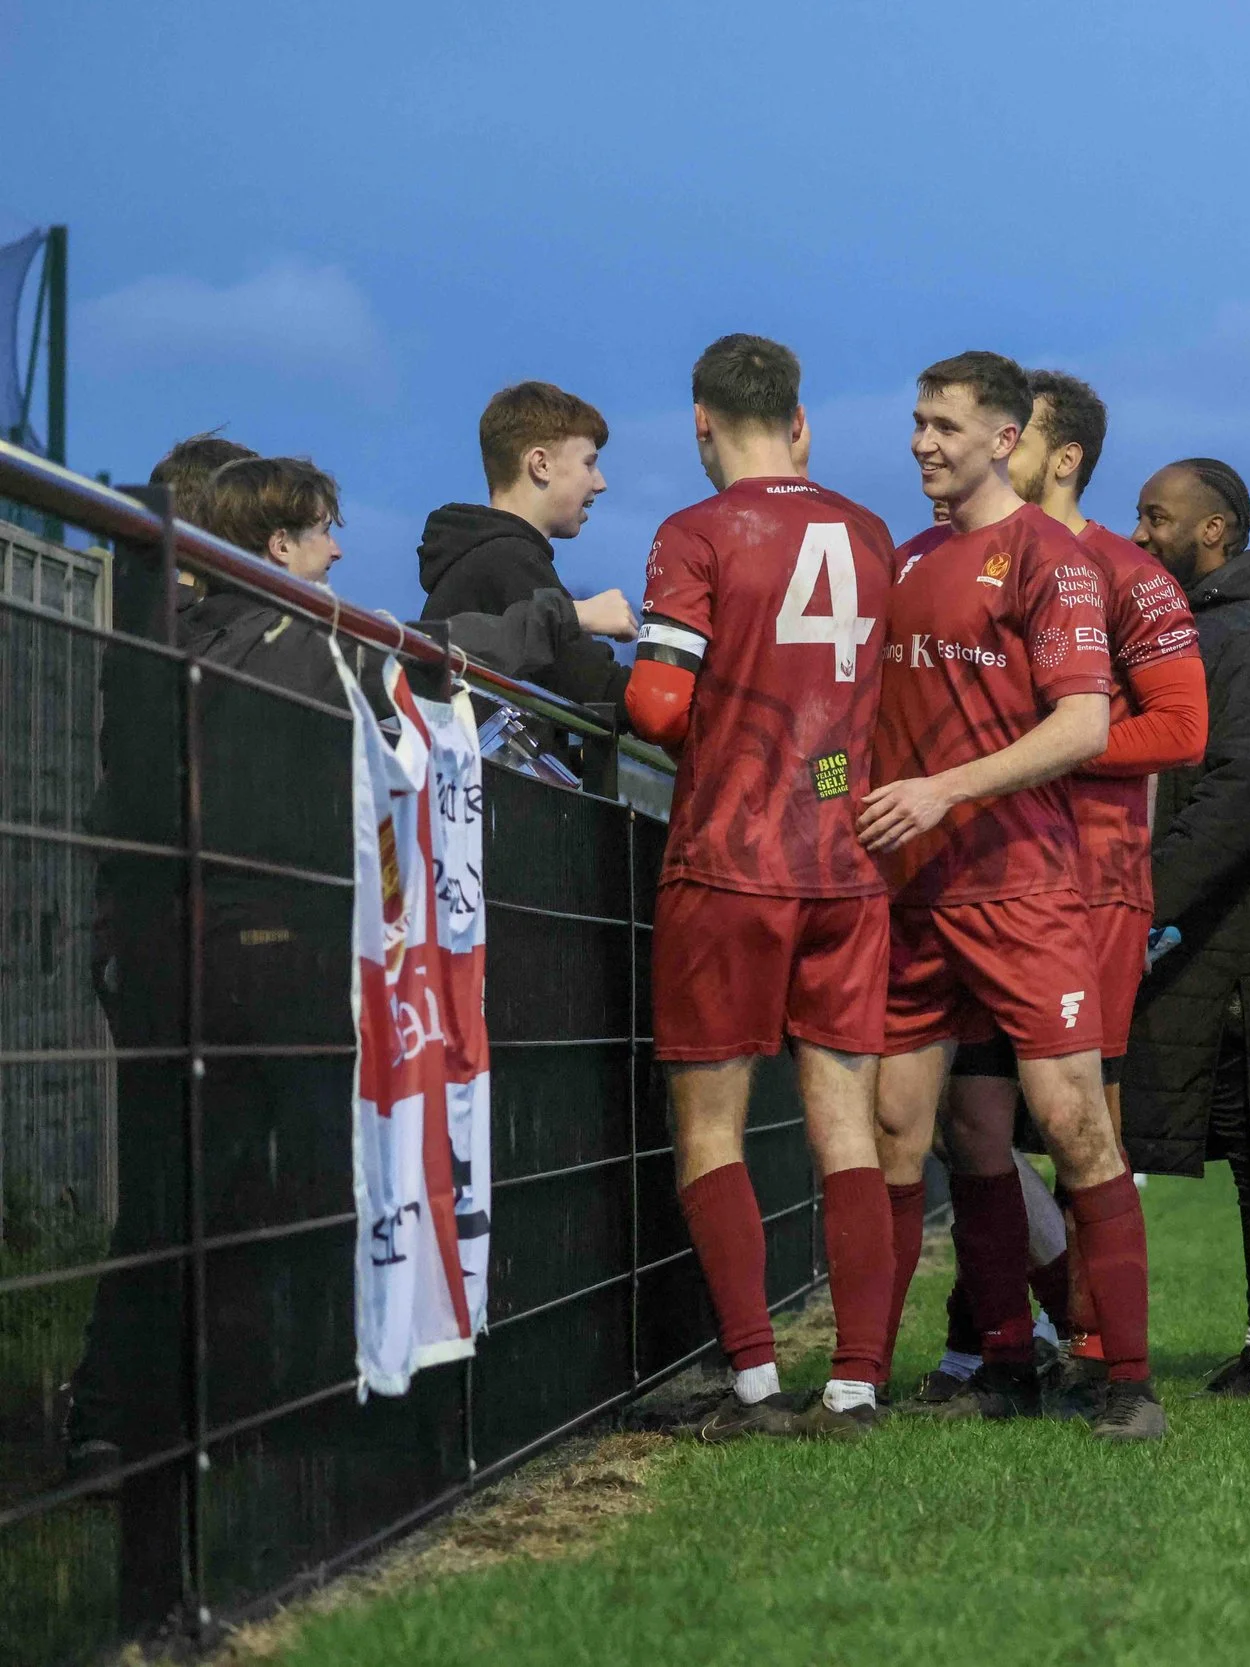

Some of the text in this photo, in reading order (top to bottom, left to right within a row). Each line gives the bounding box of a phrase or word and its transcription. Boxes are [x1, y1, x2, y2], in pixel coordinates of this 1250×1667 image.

[766, 485, 808, 494] BALHAM
[776, 522, 876, 682] 4
[1137, 584, 1176, 611] Russell
[910, 634, 935, 668] K
[937, 640, 1007, 668] Estates
[818, 753, 848, 772] BIG
[816, 767, 845, 780] YELLOW
[817, 774, 847, 791] SELF
[820, 785, 849, 798] STORAGE
